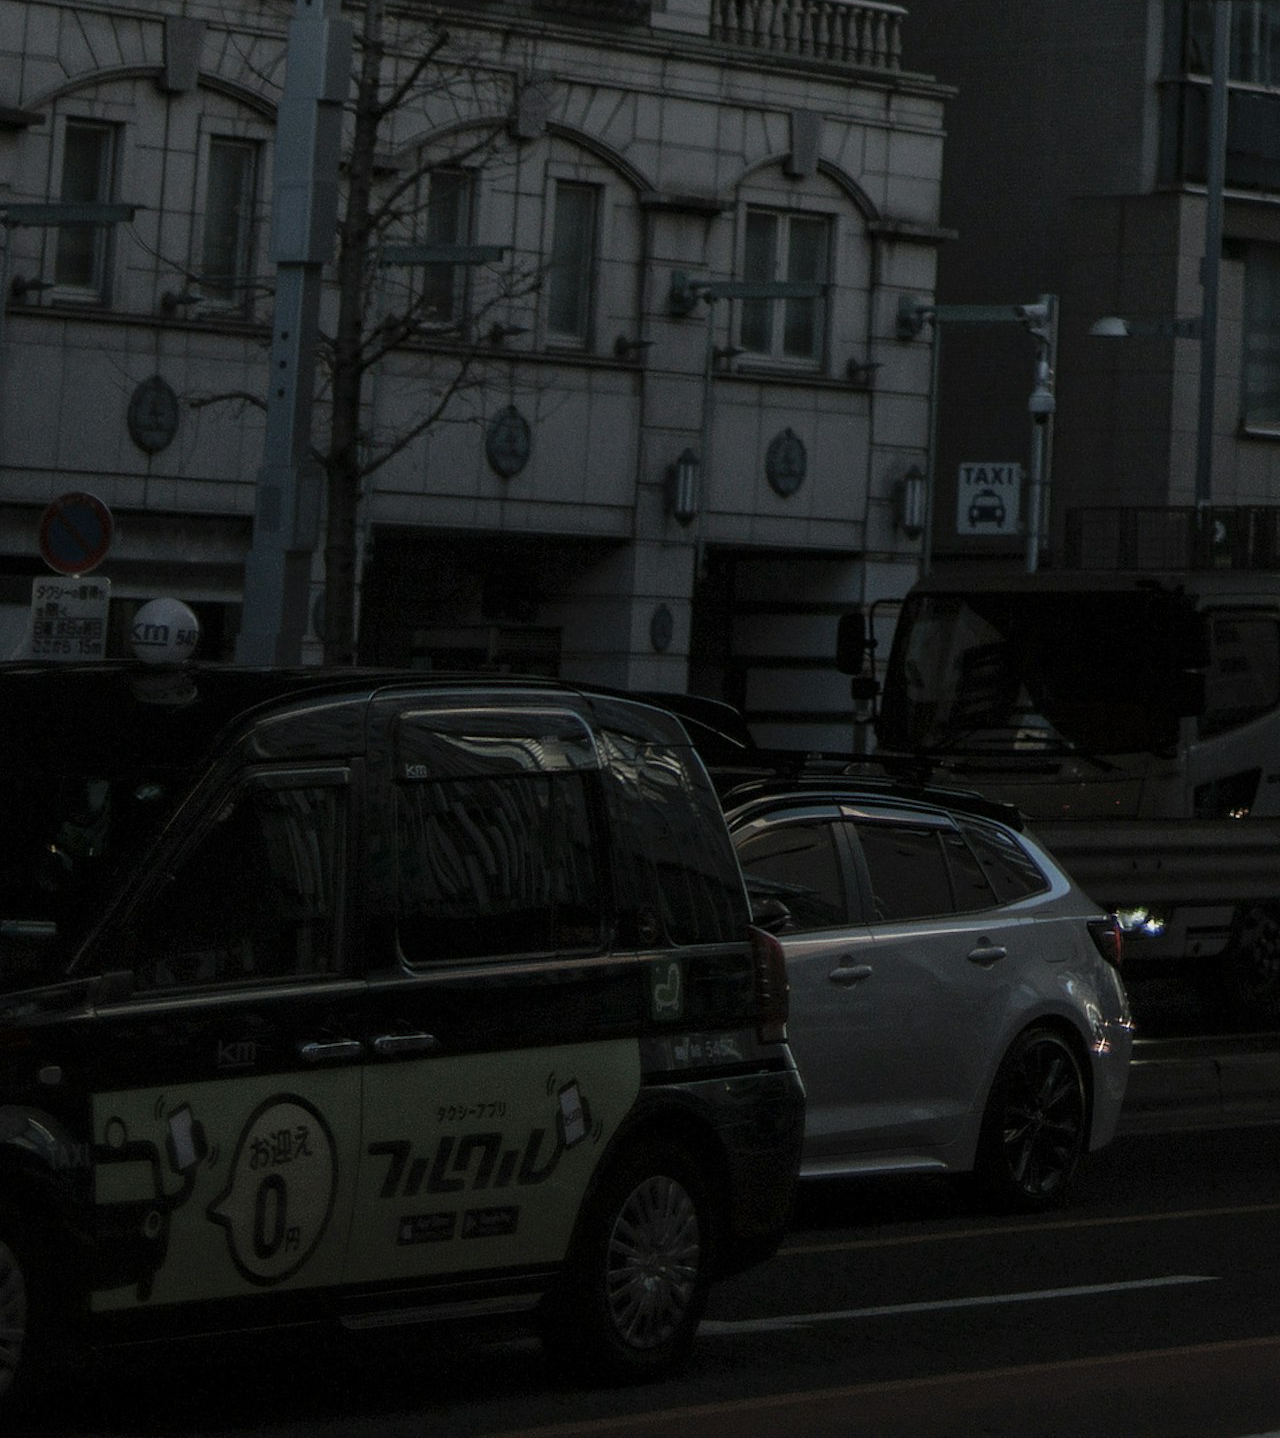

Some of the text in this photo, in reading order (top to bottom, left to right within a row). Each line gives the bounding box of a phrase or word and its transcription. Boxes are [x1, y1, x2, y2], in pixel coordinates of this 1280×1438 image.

[964, 467, 1013, 485] TAXI
[404, 763, 428, 777] km
[216, 1039, 257, 1064] km
[438, 1101, 508, 1123] タクシーアプリ
[249, 1124, 314, 1172] お迎え
[253, 1173, 301, 1260] 0 円
